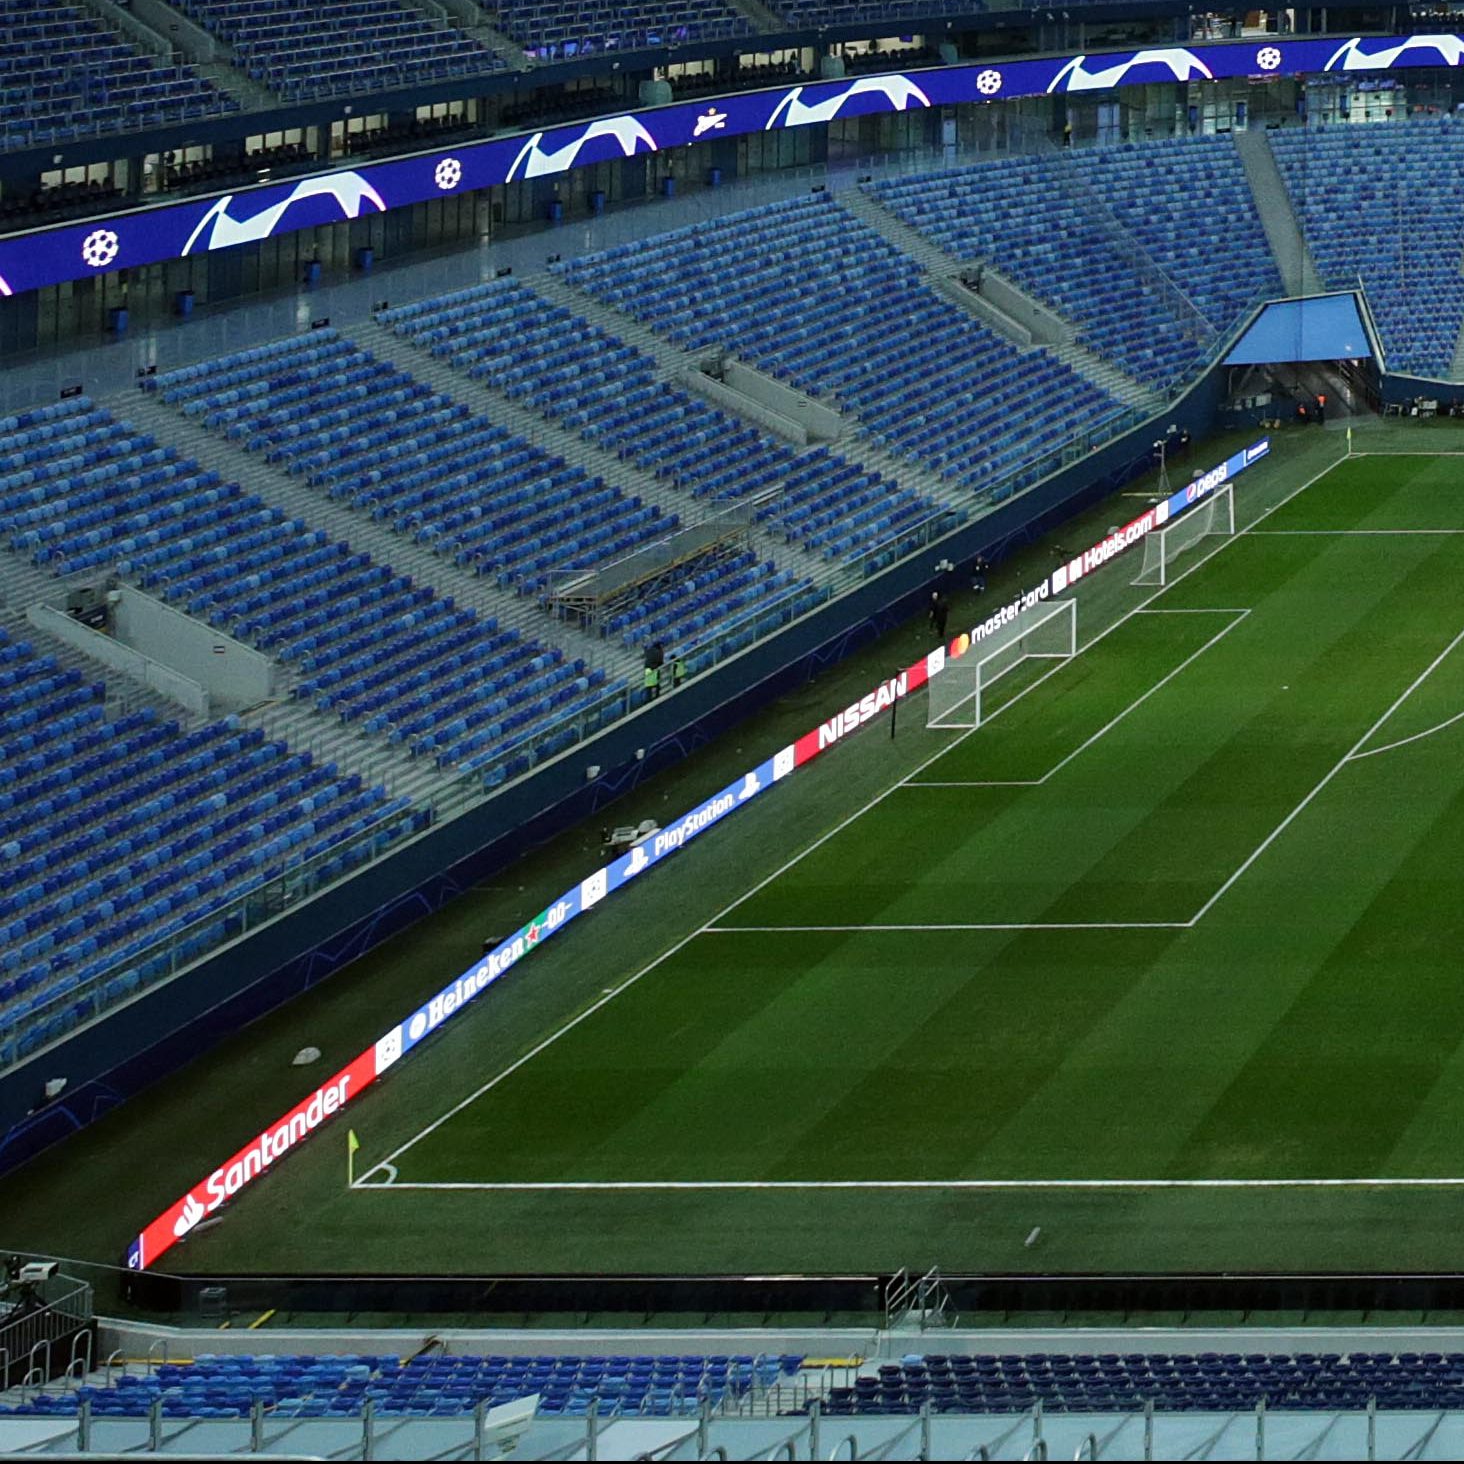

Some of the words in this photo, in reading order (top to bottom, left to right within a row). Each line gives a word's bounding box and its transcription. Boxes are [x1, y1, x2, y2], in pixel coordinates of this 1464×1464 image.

[1197, 462, 1227, 497] pepsi
[1084, 514, 1152, 573] Hotels.com
[818, 671, 907, 749] NISSAN
[654, 793, 734, 856] PlayStation
[427, 938, 525, 1029] Heineken
[206, 1074, 351, 1212] Santander
